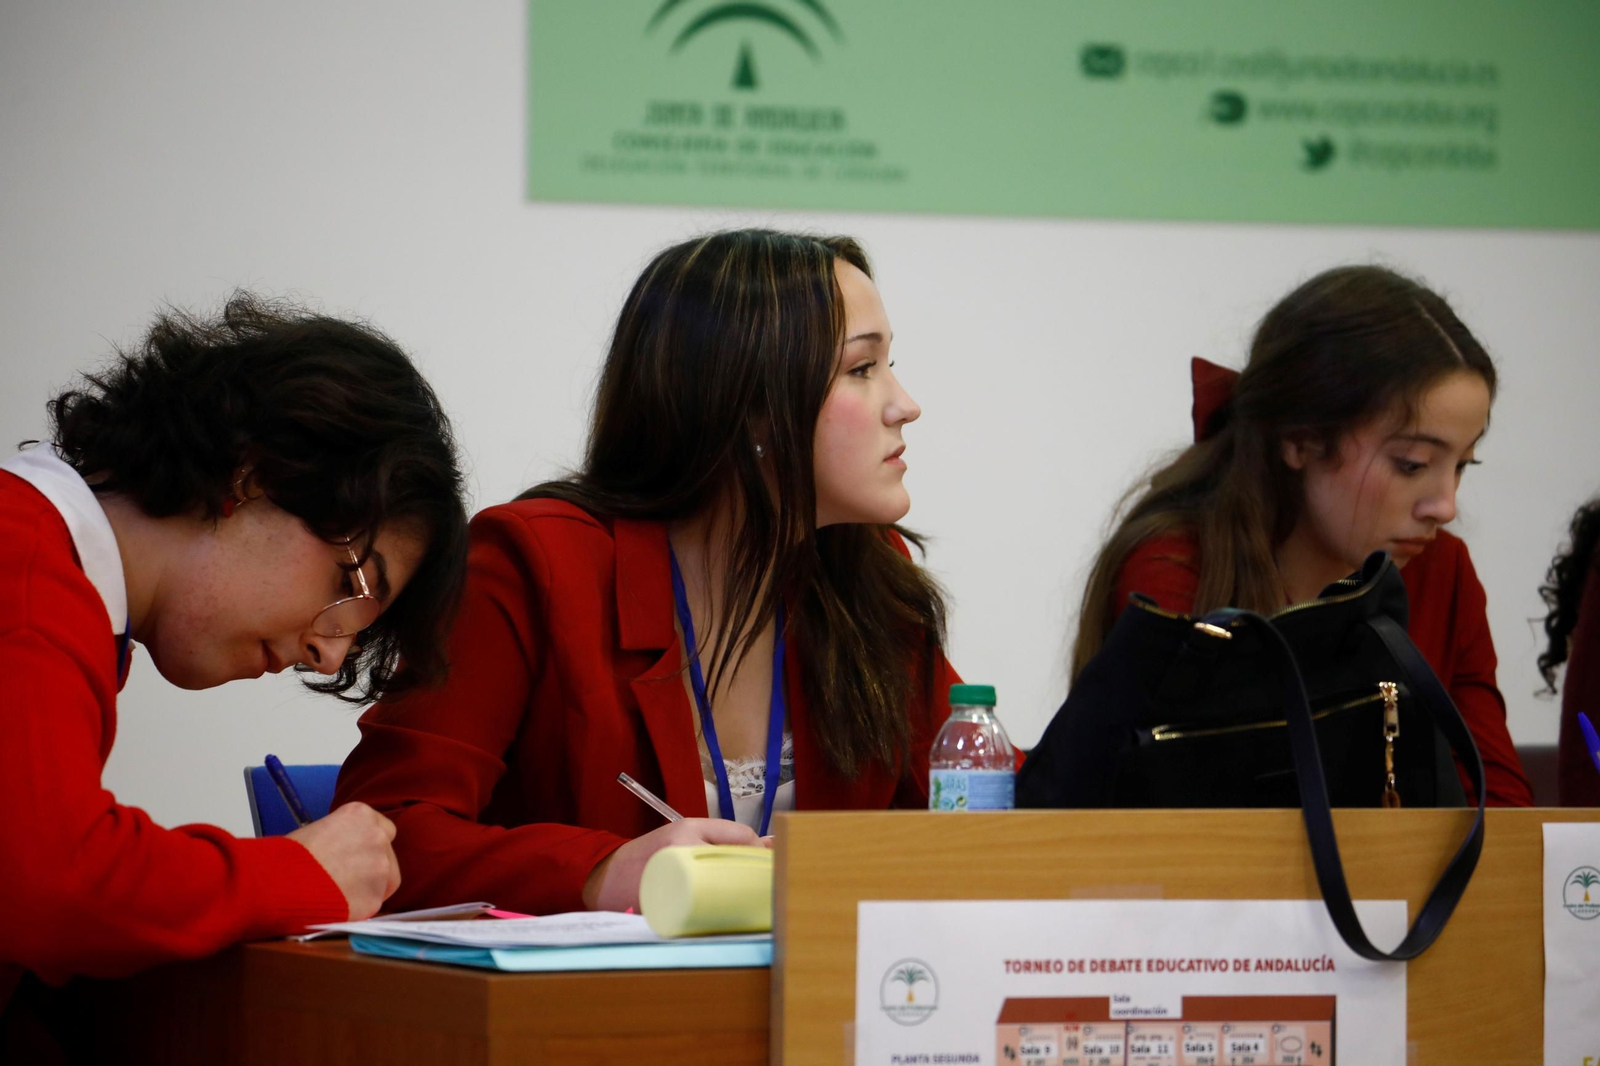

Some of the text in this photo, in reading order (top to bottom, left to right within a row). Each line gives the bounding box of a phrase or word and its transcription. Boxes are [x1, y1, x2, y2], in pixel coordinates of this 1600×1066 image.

[1004, 954, 1336, 973] TORNEO DE DEBATE EDUCATIVO DE ANDALUCÍA
[1020, 1045, 1040, 1055] Sala
[1083, 1044, 1103, 1055] Sala
[1130, 1044, 1150, 1054] Sala
[1185, 1043, 1205, 1053] Sala
[1231, 1042, 1250, 1053] Sala
